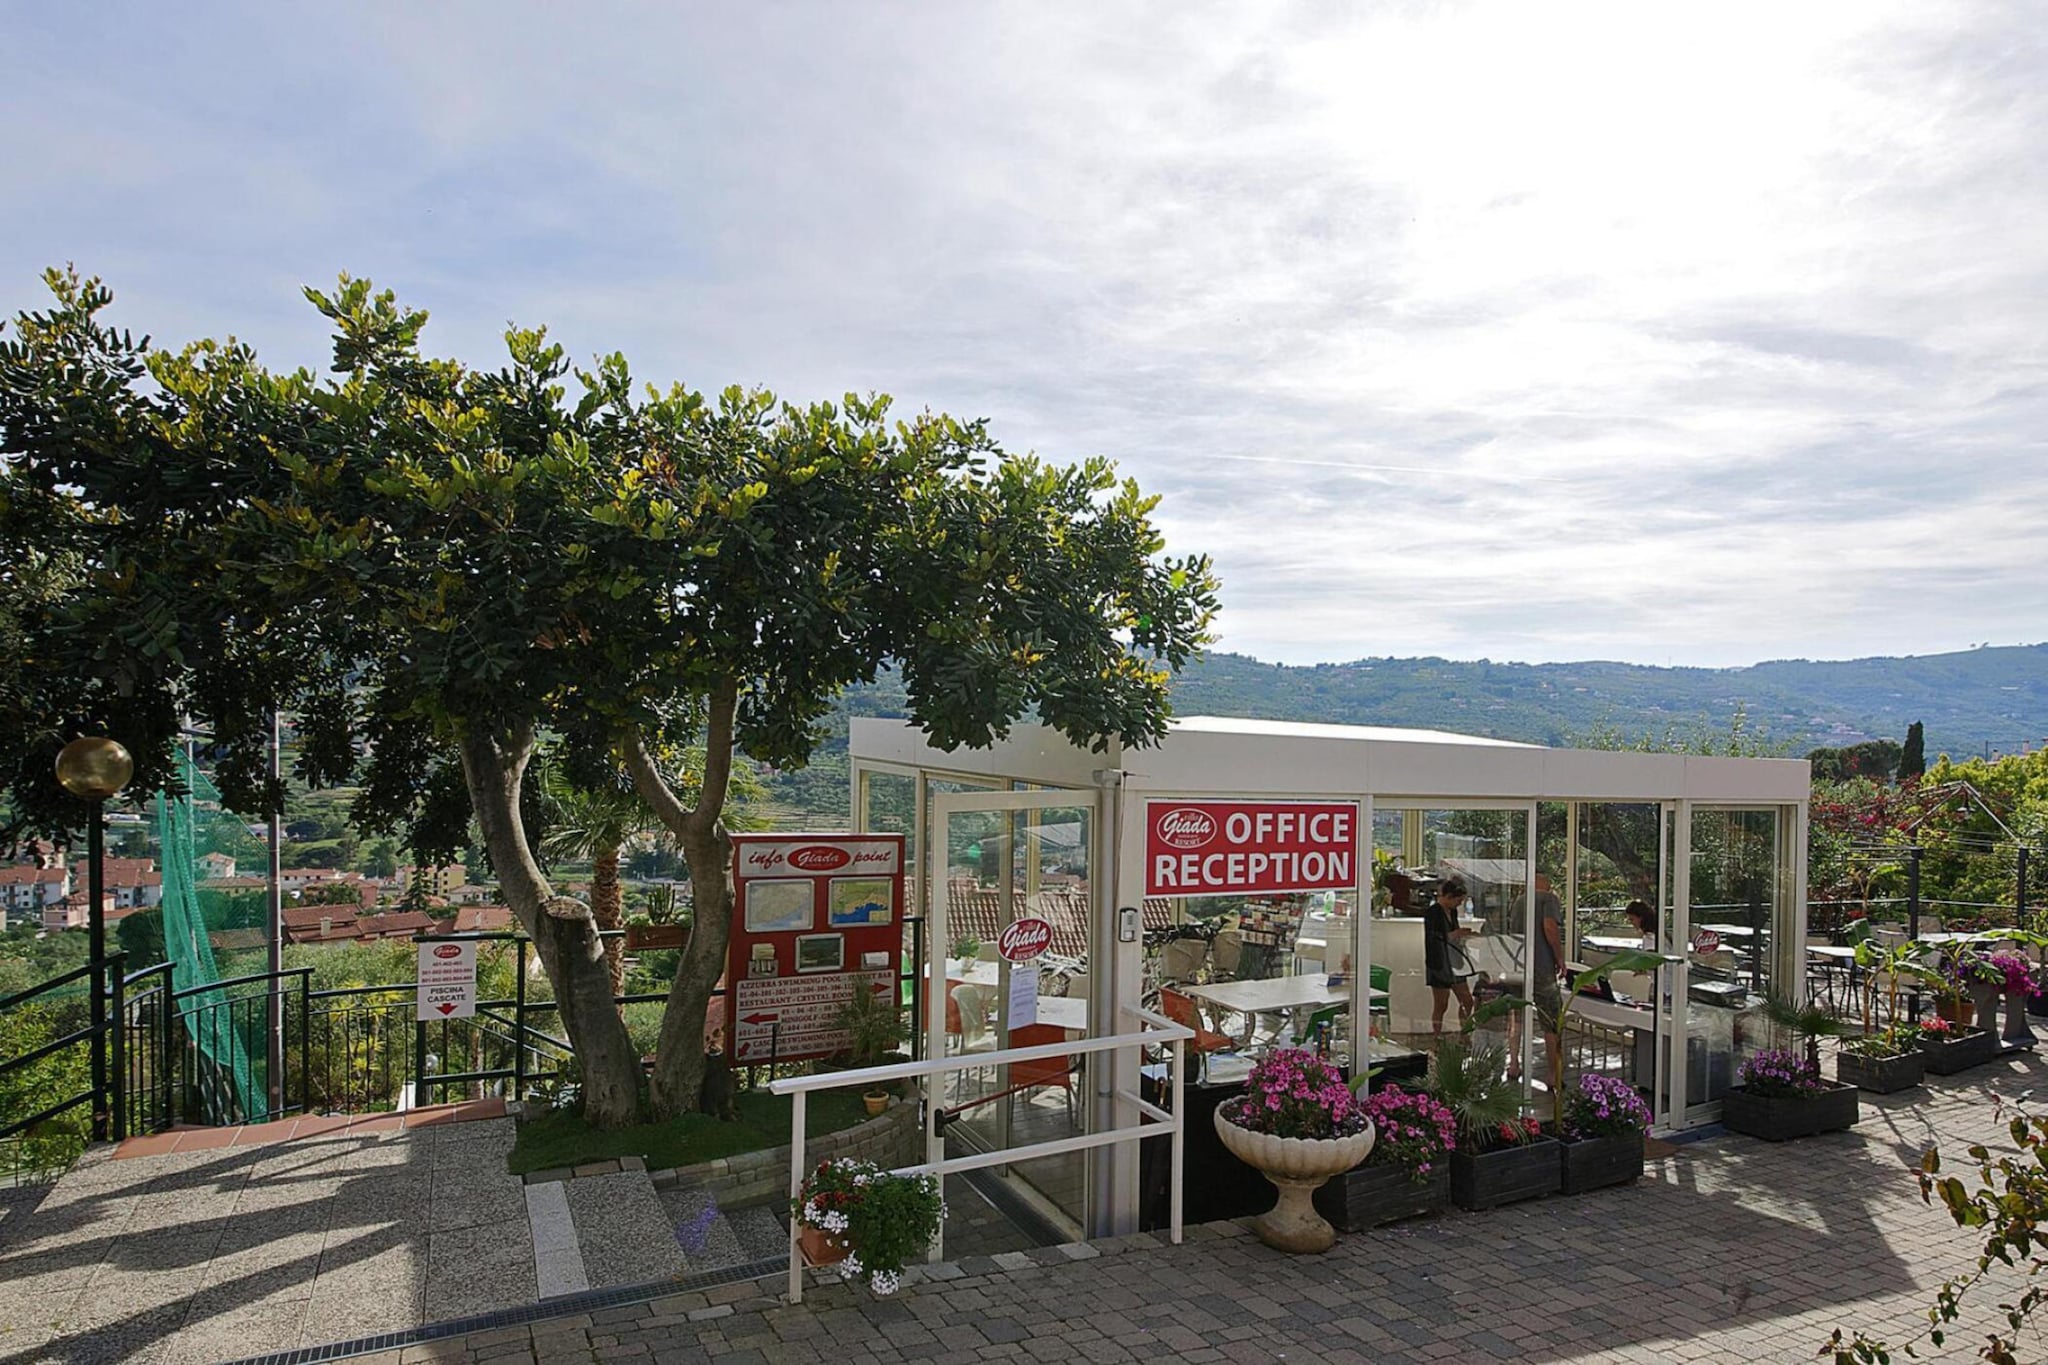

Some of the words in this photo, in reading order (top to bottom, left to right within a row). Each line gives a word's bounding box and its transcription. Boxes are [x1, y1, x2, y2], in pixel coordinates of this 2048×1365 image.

[1163, 812, 1211, 841] Giada
[1225, 812, 1349, 844] OFFICE
[748, 848, 784, 869] info
[797, 851, 839, 866] Giada
[852, 850, 892, 866] point
[1155, 851, 1349, 888] RECEPTION
[1003, 922, 1048, 957] Giada
[430, 986, 464, 995] PISCINA
[778, 976, 821, 986] SWIMMING
[822, 975, 841, 983] POOL
[427, 994, 466, 1003] CASCATE
[739, 997, 791, 1007] RESTAURANT
